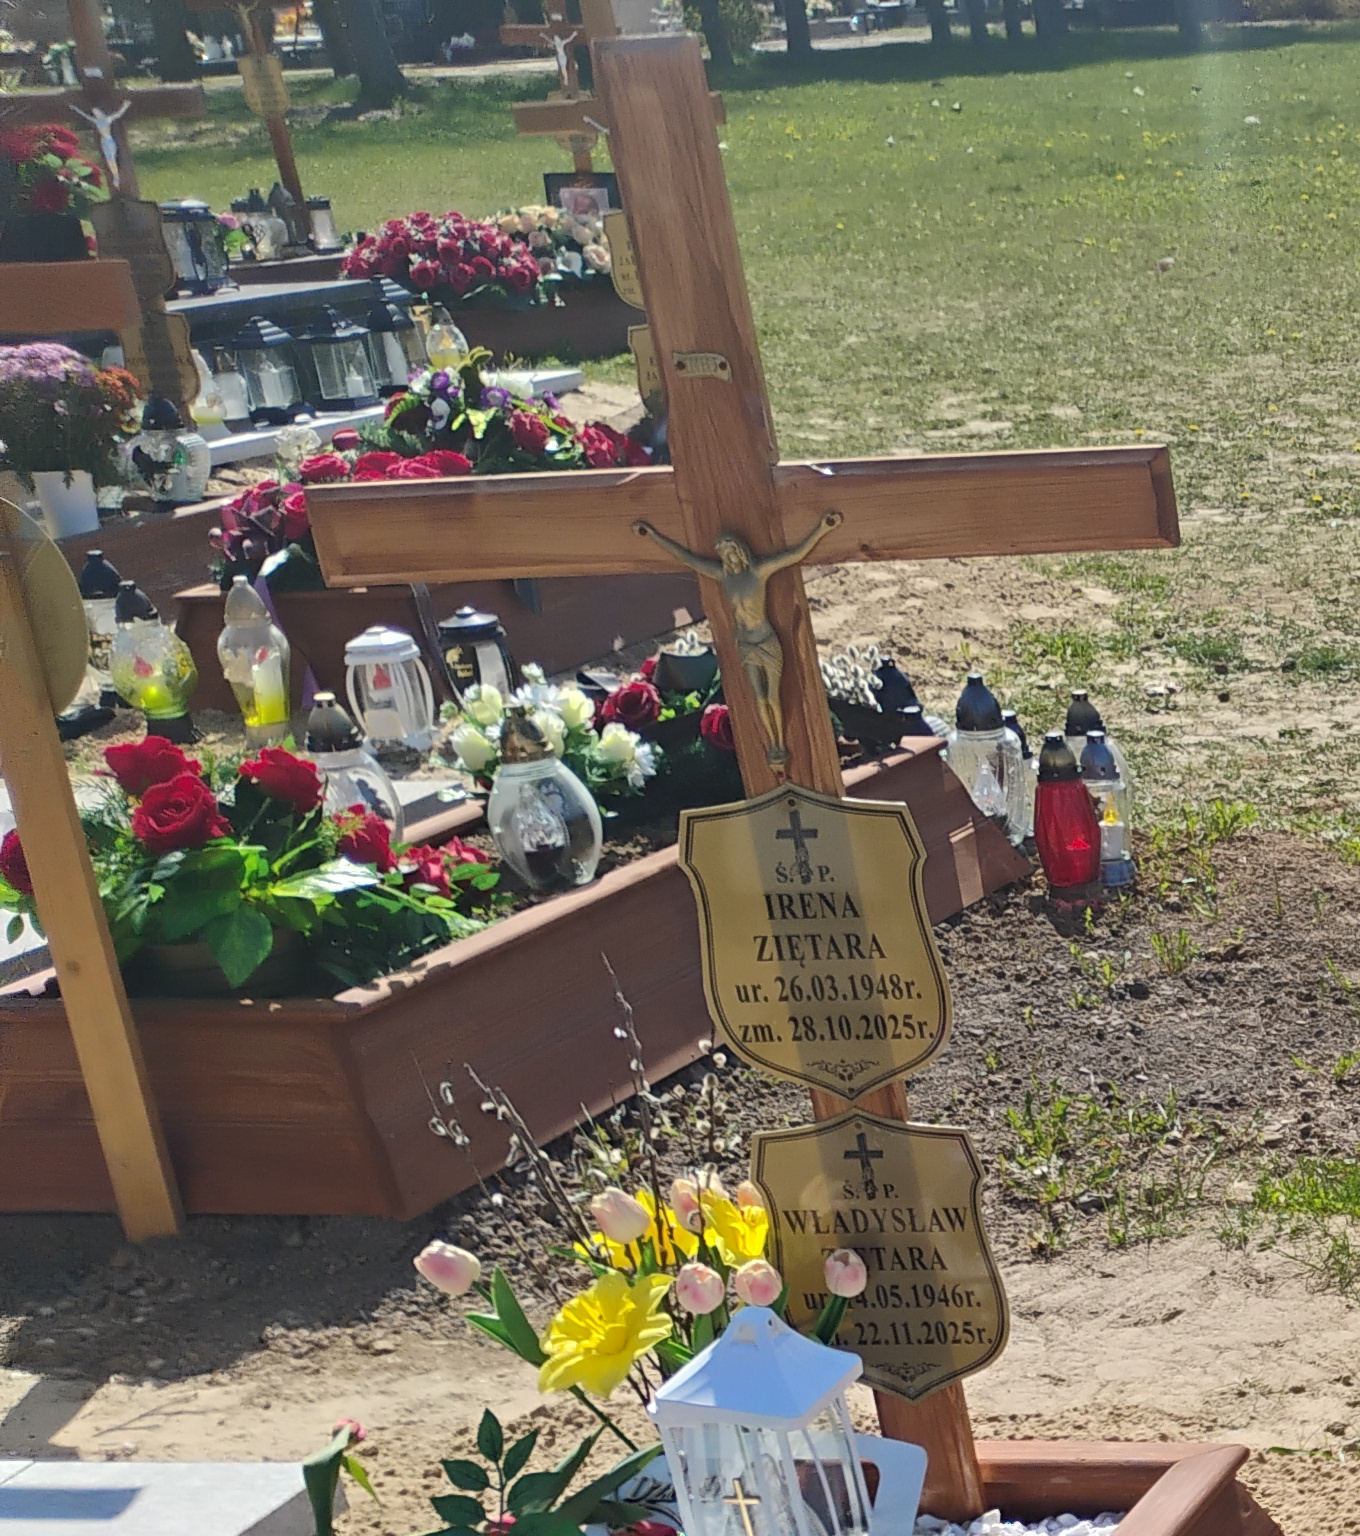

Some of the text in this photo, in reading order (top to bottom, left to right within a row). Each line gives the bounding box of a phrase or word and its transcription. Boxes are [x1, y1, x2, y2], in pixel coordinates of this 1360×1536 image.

[763, 891, 861, 921] IRENA
[753, 932, 887, 968] ZIĘTARA
[735, 973, 923, 1003] ur. 26.03.1948r.
[738, 1014, 935, 1043] zm. 28.10.2025r.
[782, 1206, 969, 1235] WŁADYSŁAW
[820, 1246, 949, 1279] TARA
[846, 1283, 982, 1310] 4.05.1946r.
[854, 1320, 994, 1346] 22.11.2025r.
